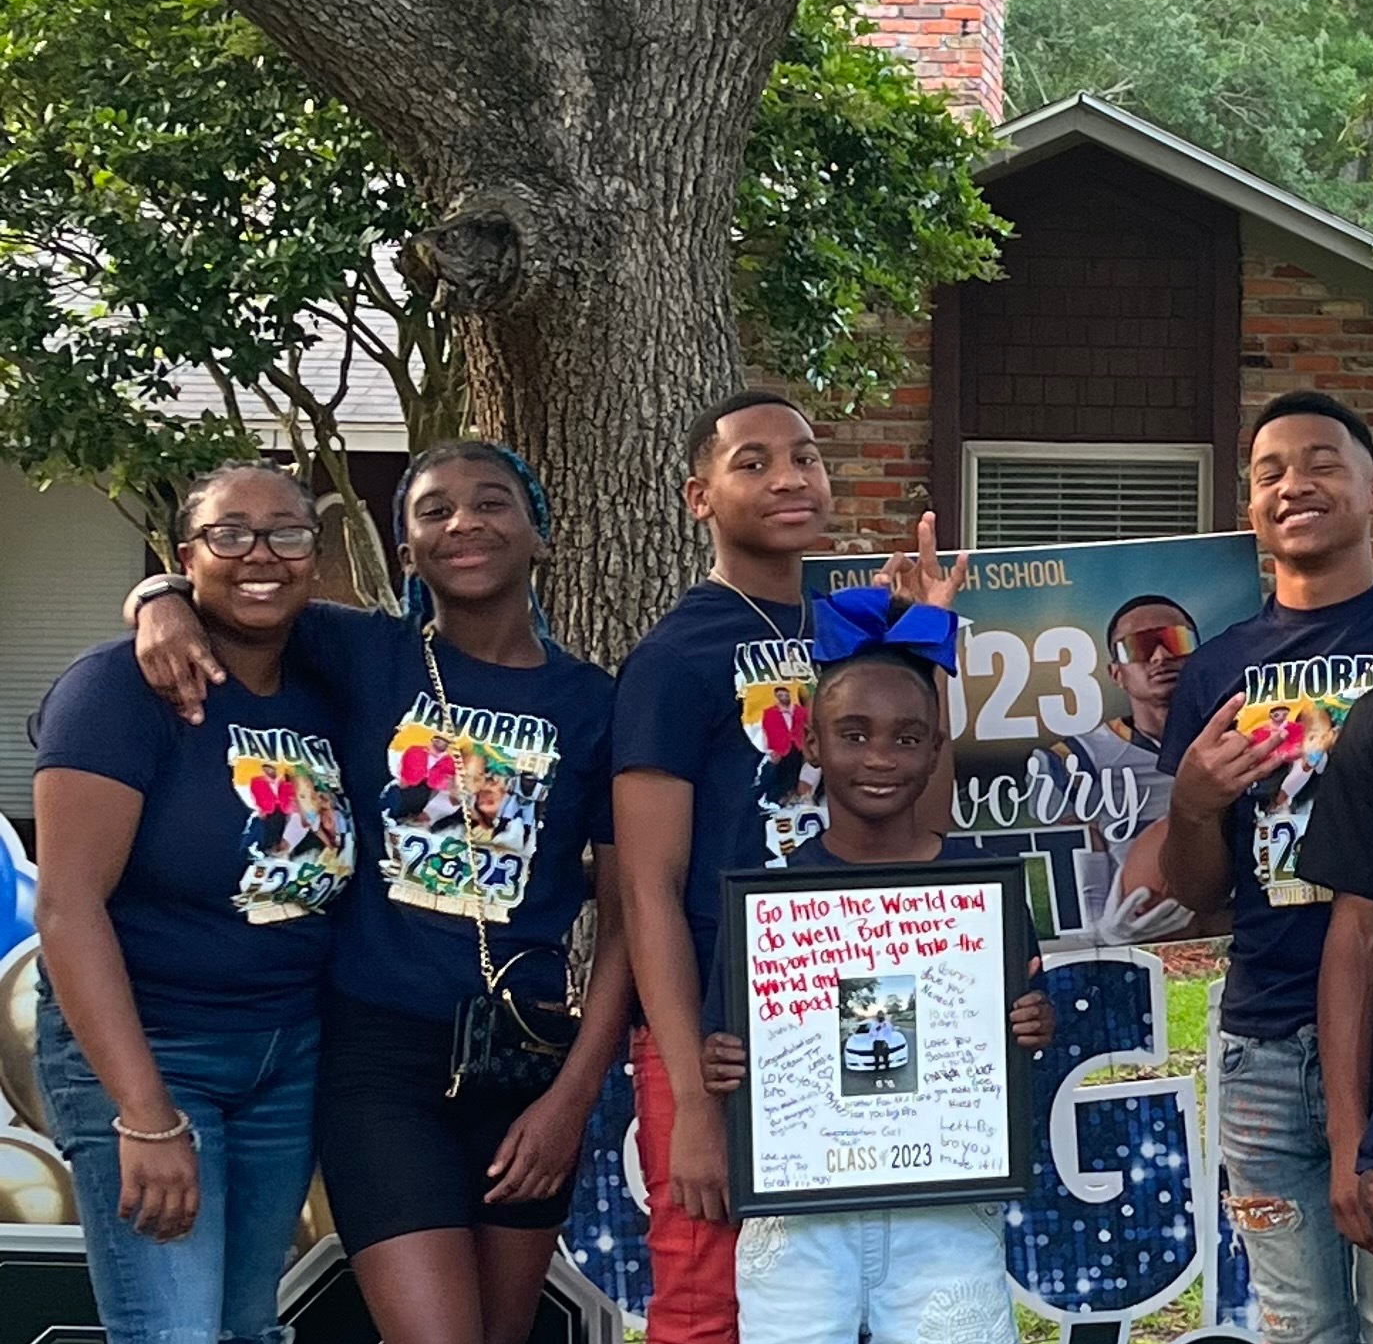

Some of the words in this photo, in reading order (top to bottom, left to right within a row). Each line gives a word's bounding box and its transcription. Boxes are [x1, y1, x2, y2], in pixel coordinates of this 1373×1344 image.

[985, 559, 1073, 589] SCHOOL
[411, 691, 560, 754] JAVORRY
[951, 754, 1150, 843] vorry
[756, 899, 782, 924] Go
[833, 895, 875, 918] the
[951, 889, 986, 914] and
[757, 927, 785, 953] do
[899, 916, 957, 935] more
[886, 941, 909, 965] go
[759, 997, 784, 1022] do
[826, 1146, 877, 1173] CLASS
[891, 1143, 933, 1169] 2023
